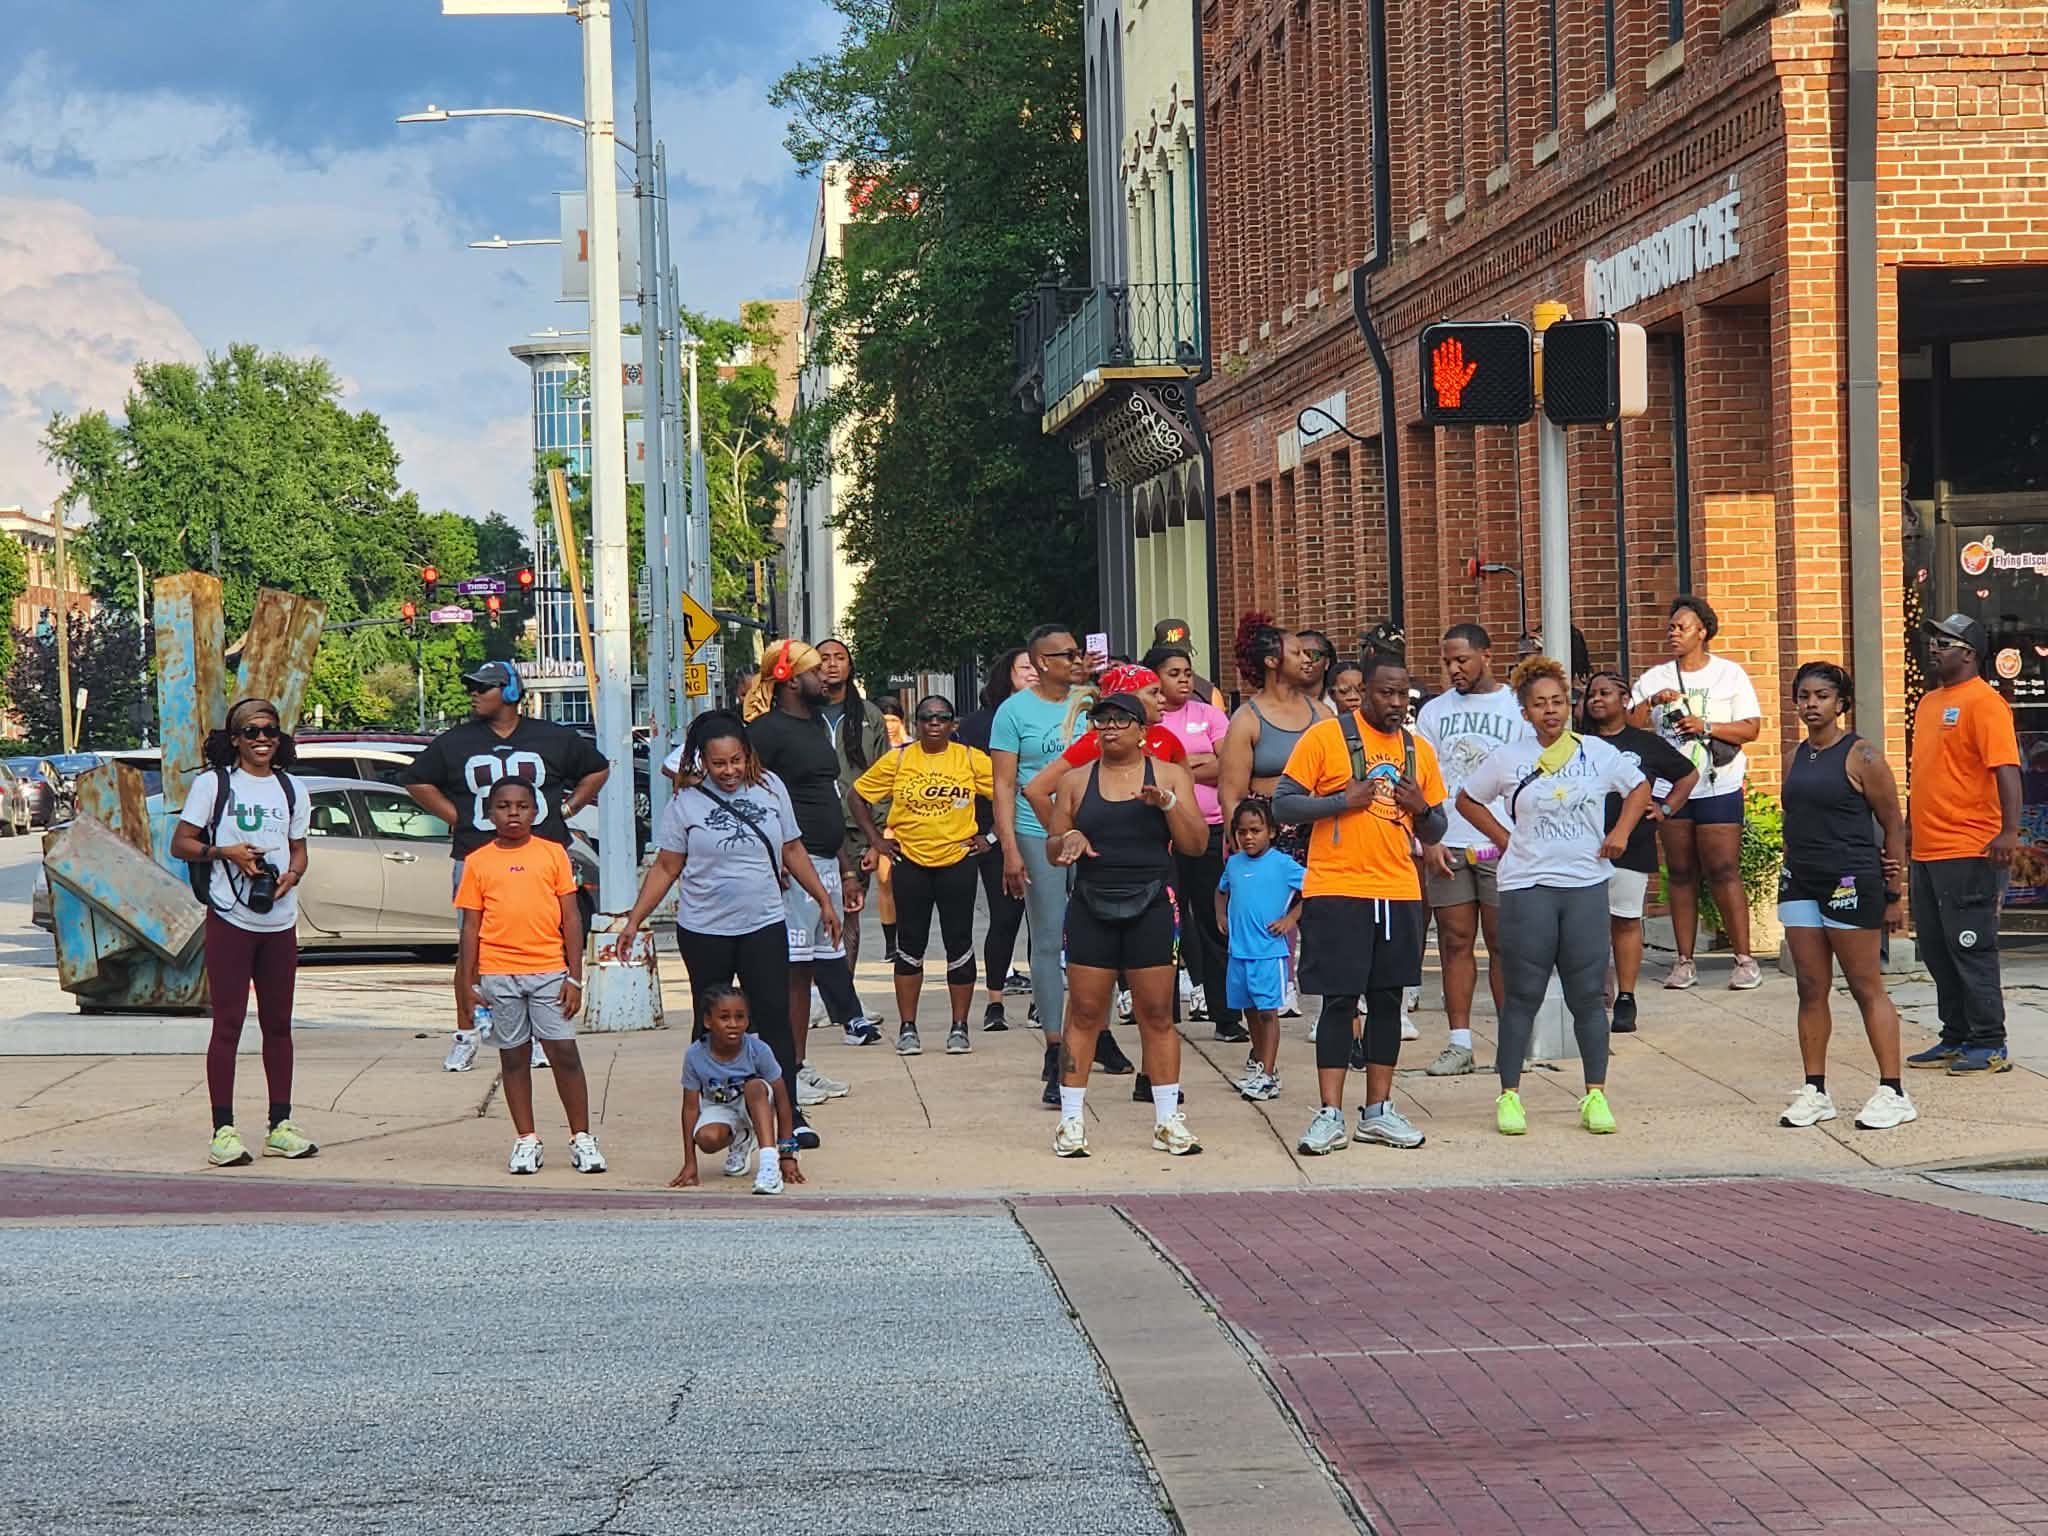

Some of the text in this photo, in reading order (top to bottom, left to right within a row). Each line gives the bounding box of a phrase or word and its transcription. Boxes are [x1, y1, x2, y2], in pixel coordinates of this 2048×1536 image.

[684, 667, 699, 681] ED
[685, 681, 701, 693] NG
[1440, 711, 1512, 744] DENALI
[1516, 761, 1600, 780] GRGIA
[925, 785, 971, 800] GEAR
